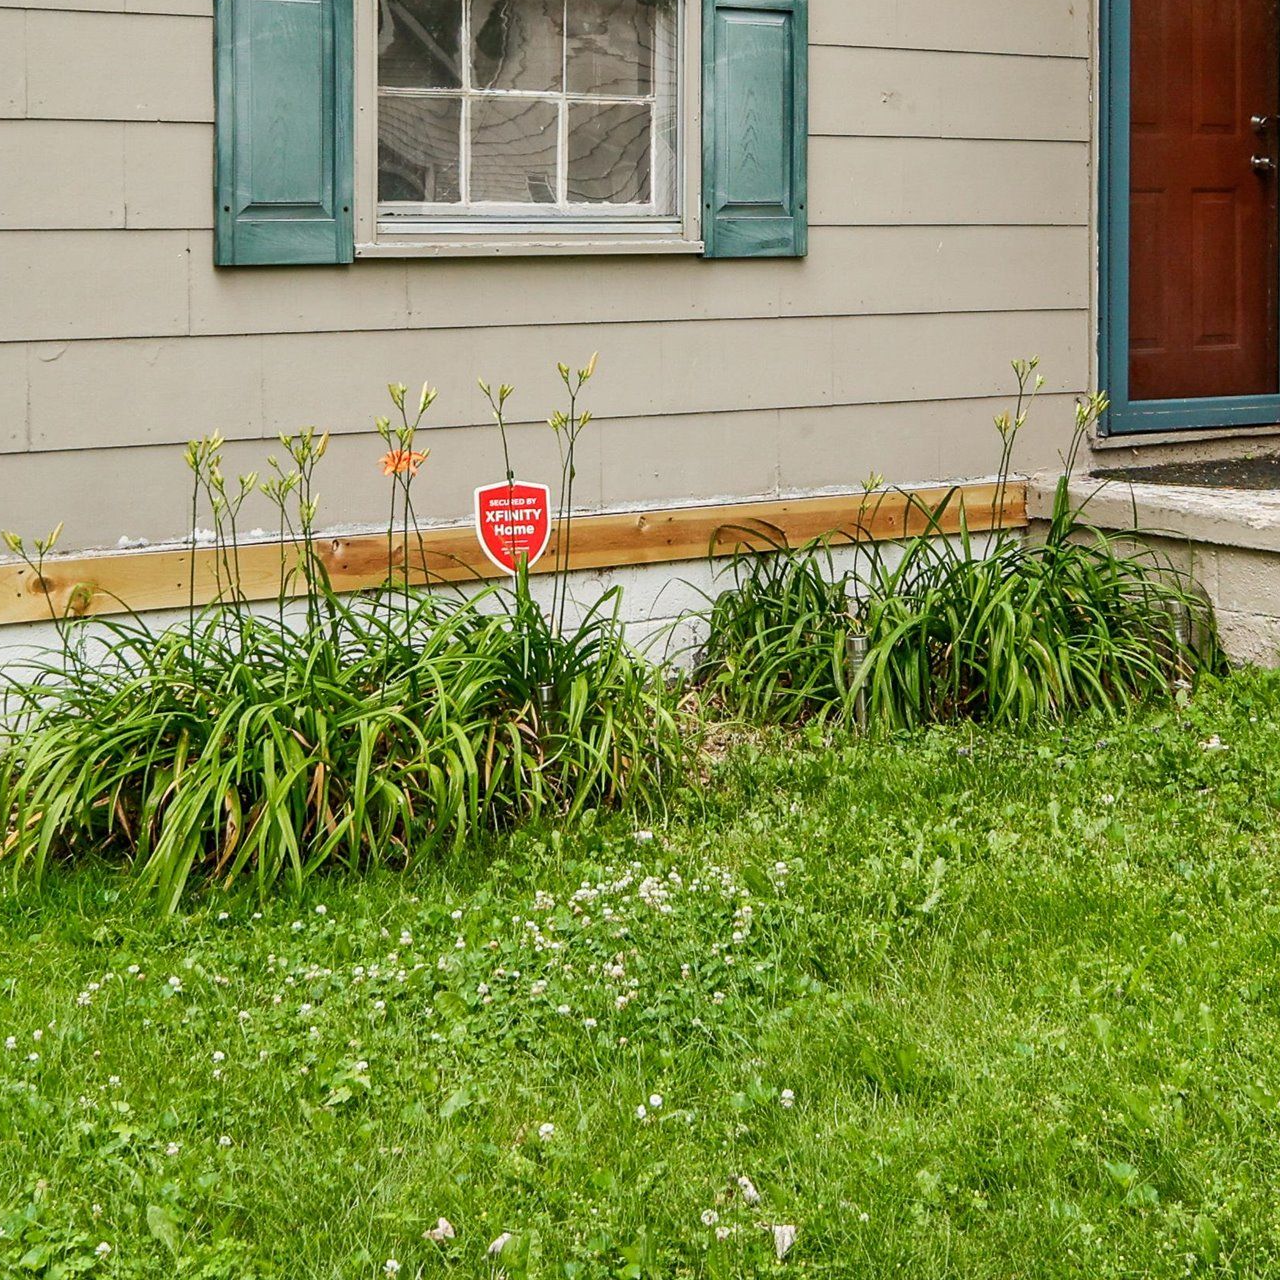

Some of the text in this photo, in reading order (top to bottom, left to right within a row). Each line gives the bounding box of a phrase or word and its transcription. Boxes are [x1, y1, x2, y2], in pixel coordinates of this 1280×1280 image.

[526, 497, 537, 505] BY
[485, 508, 542, 523] XFINITY
[494, 524, 535, 536] Home
